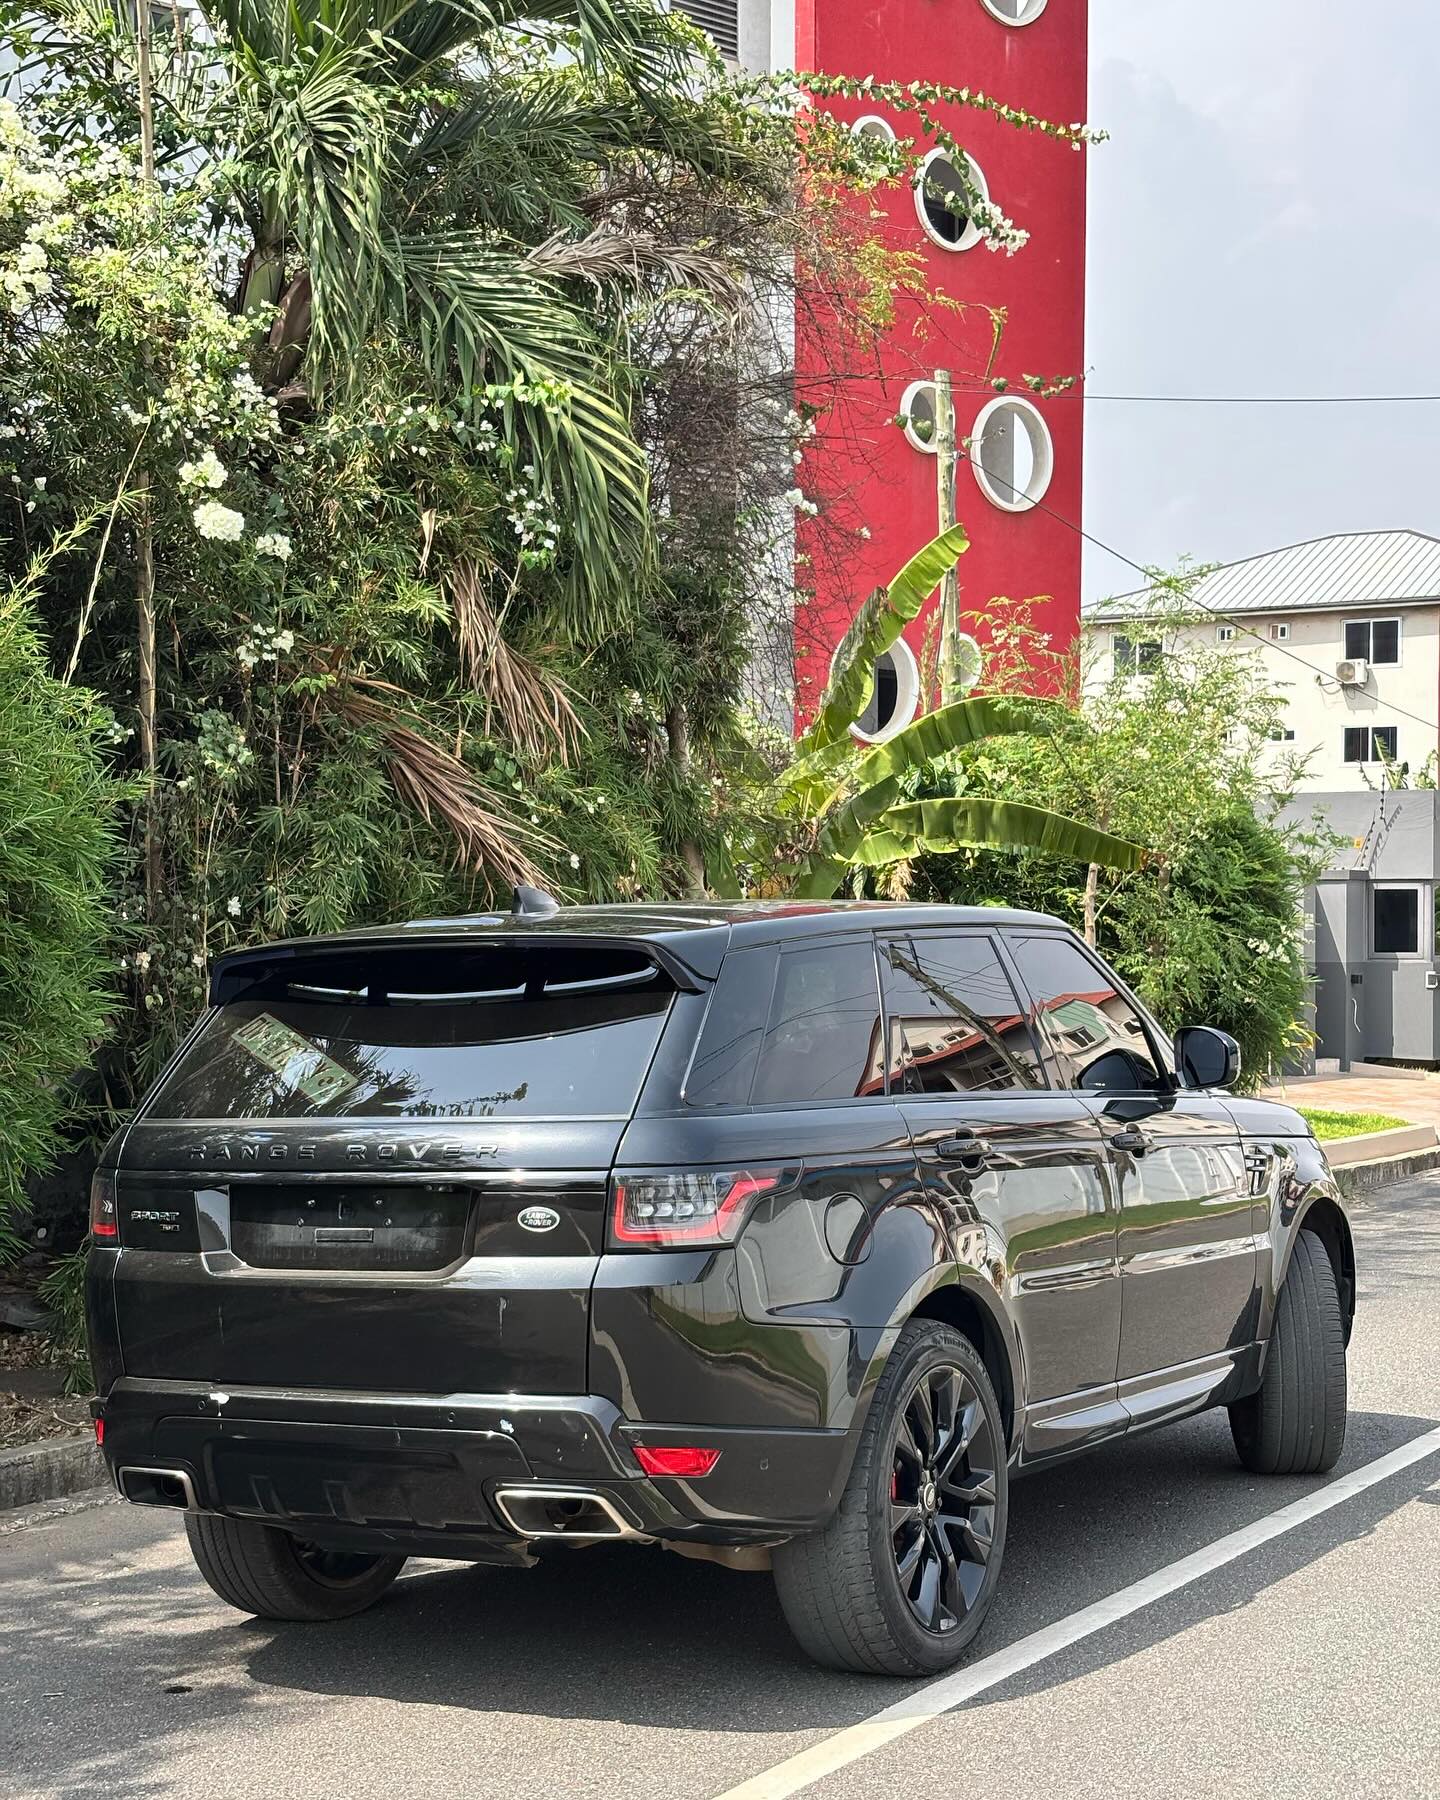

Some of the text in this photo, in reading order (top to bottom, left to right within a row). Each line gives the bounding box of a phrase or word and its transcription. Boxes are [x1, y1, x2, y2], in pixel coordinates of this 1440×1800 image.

[190, 1143, 499, 1160] RANGE ROVER
[131, 1210, 180, 1221] SPORT
[526, 1211, 546, 1219] LAND
[527, 1218, 552, 1226] ROVER
